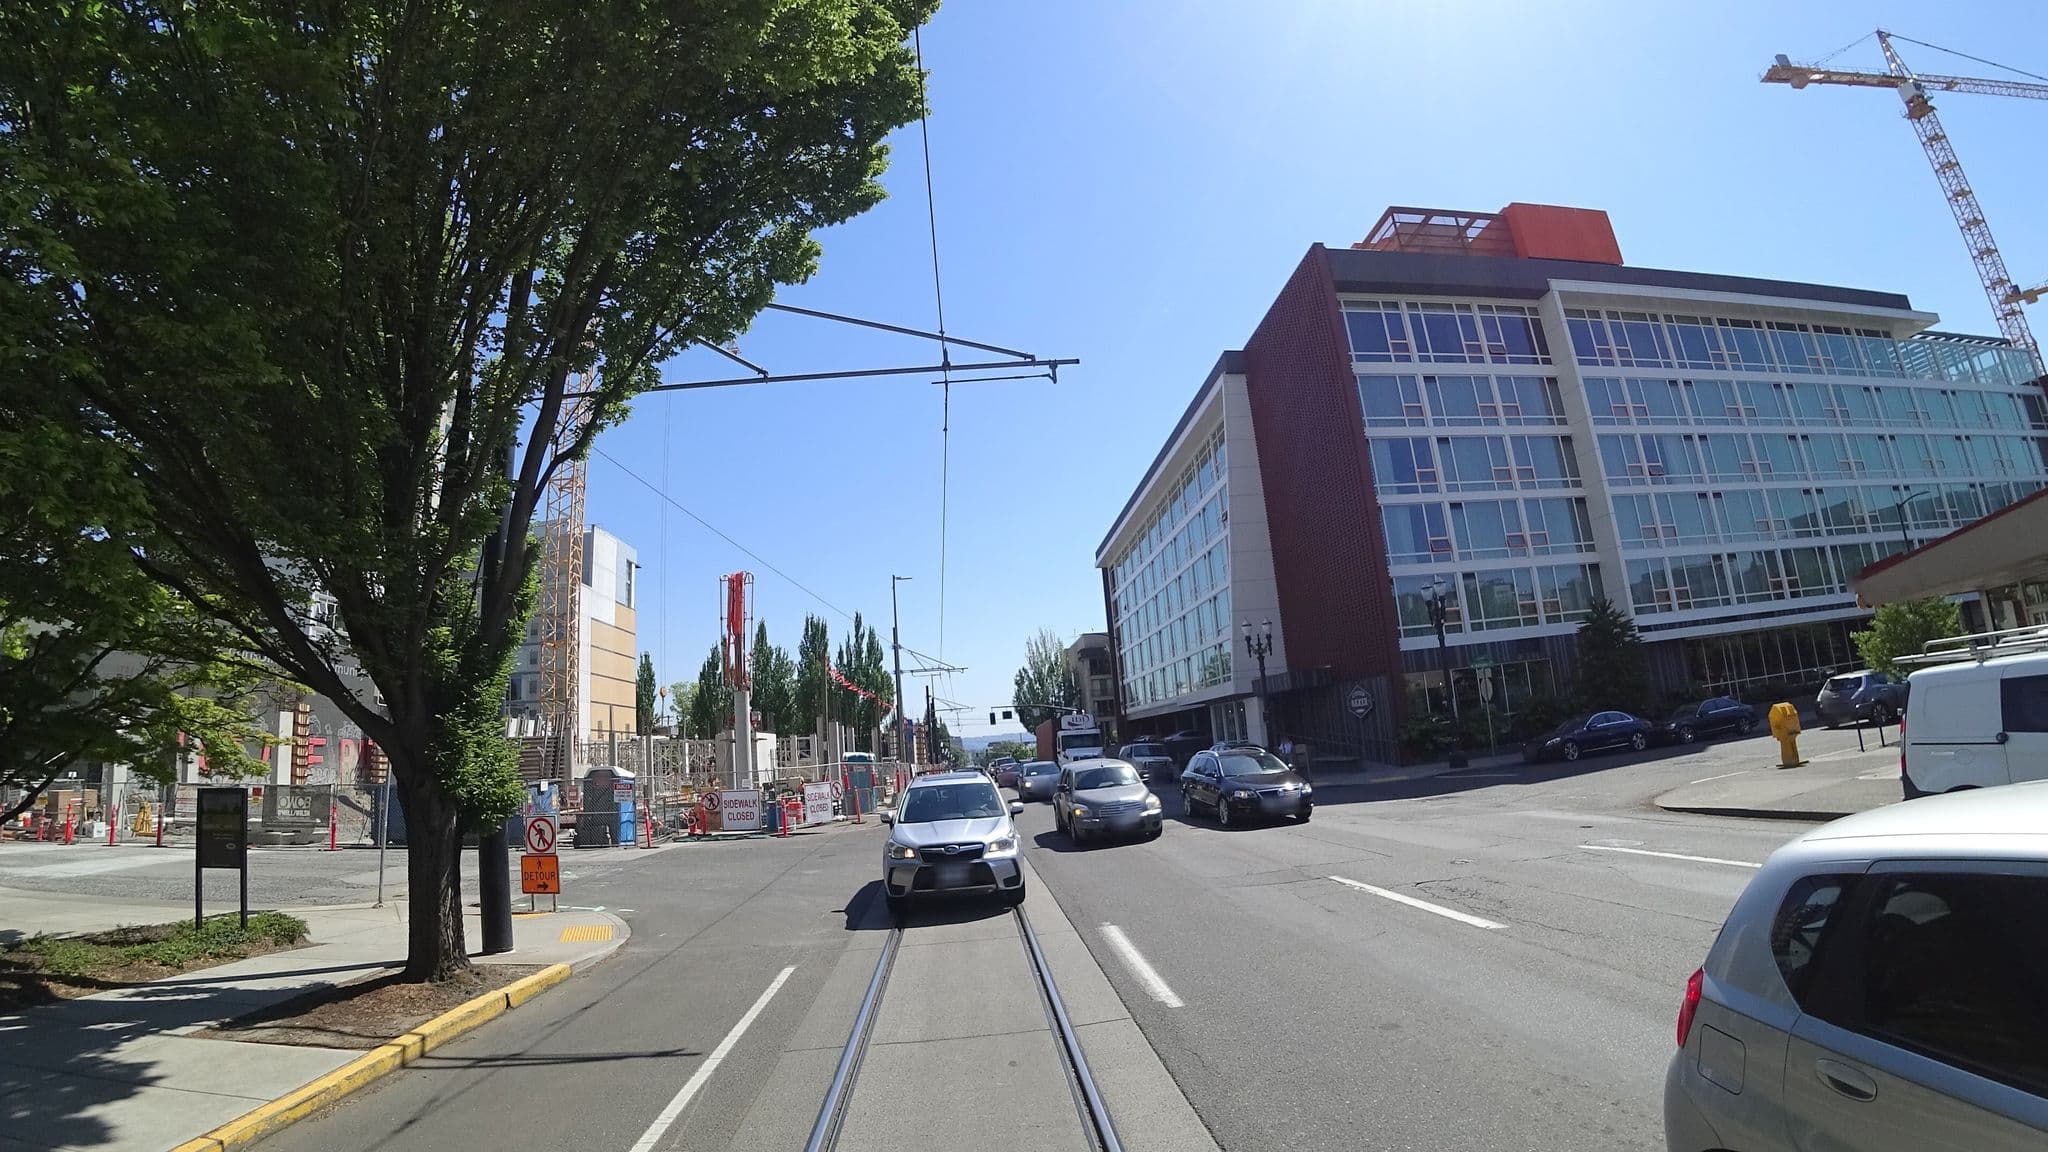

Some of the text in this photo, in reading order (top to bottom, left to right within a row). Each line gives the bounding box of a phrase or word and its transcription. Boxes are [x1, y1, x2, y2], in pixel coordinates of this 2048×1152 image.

[807, 792, 829, 801] SIDEWALK
[724, 799, 757, 808] SIDEWALK
[810, 803, 828, 813] CLOSED
[728, 812, 754, 820] CLOSED
[524, 872, 555, 880] DETOUR
